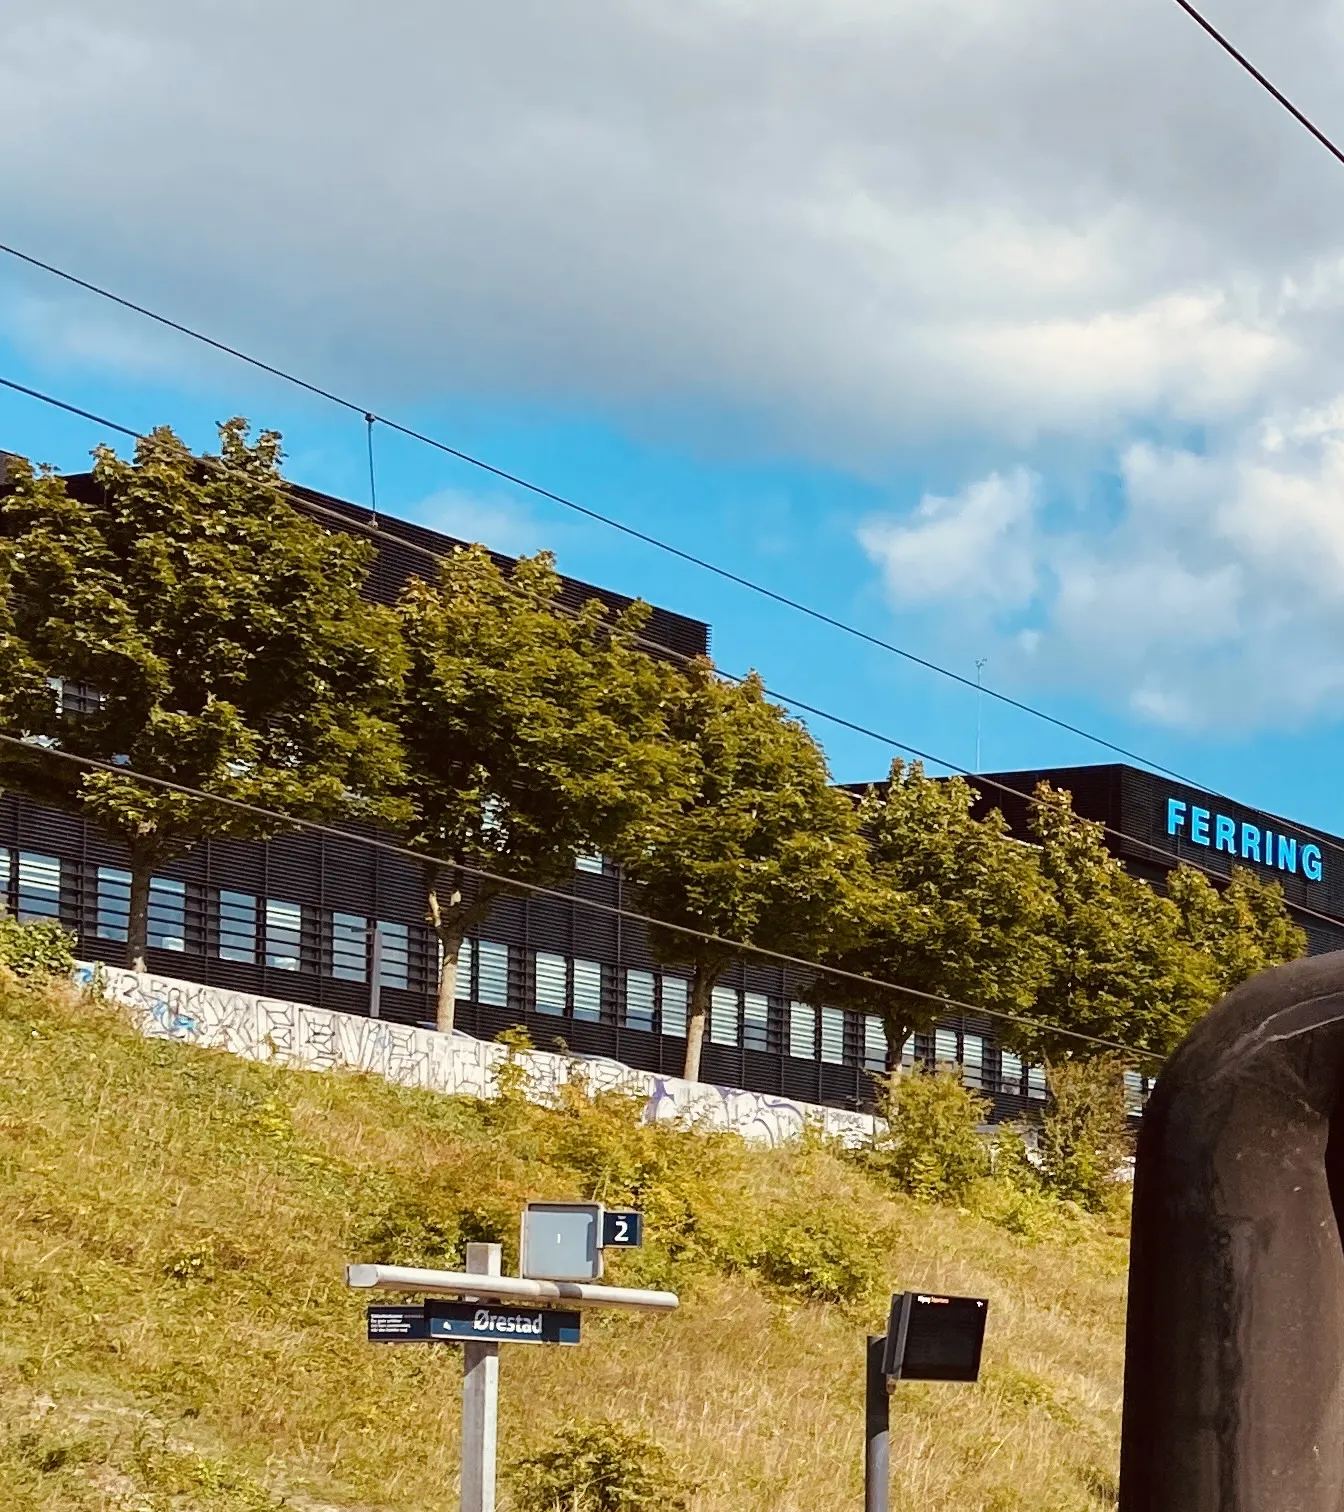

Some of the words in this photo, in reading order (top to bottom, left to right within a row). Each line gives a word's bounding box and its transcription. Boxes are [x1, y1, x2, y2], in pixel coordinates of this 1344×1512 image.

[1167, 797, 1323, 882] FERRING
[613, 1220, 630, 1242] 2
[472, 1309, 543, 1335] Ørestad
